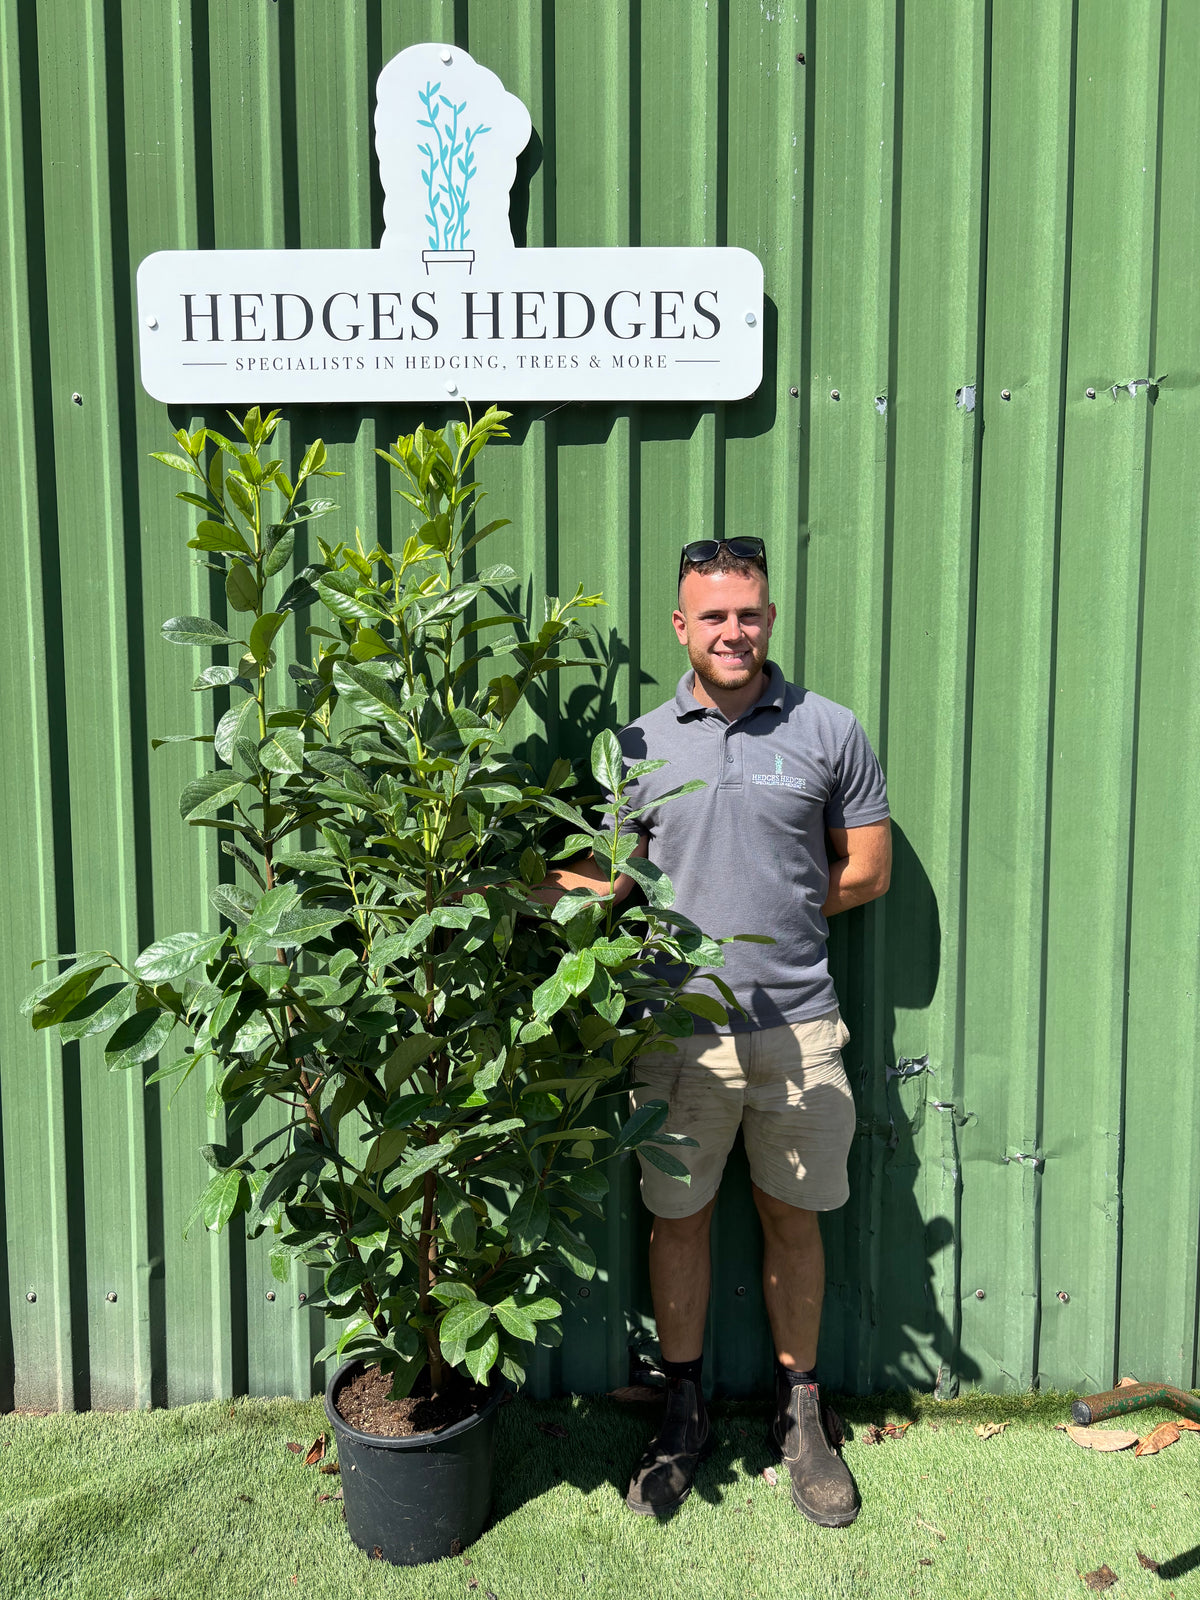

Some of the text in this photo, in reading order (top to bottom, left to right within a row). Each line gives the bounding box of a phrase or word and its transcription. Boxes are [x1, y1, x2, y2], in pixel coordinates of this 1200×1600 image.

[180, 290, 721, 342] HEDGES HEDGES
[235, 354, 667, 371] SPECIALISTS IN HEDGING, TREES & MORE
[780, 775, 806, 785] HEDGES
